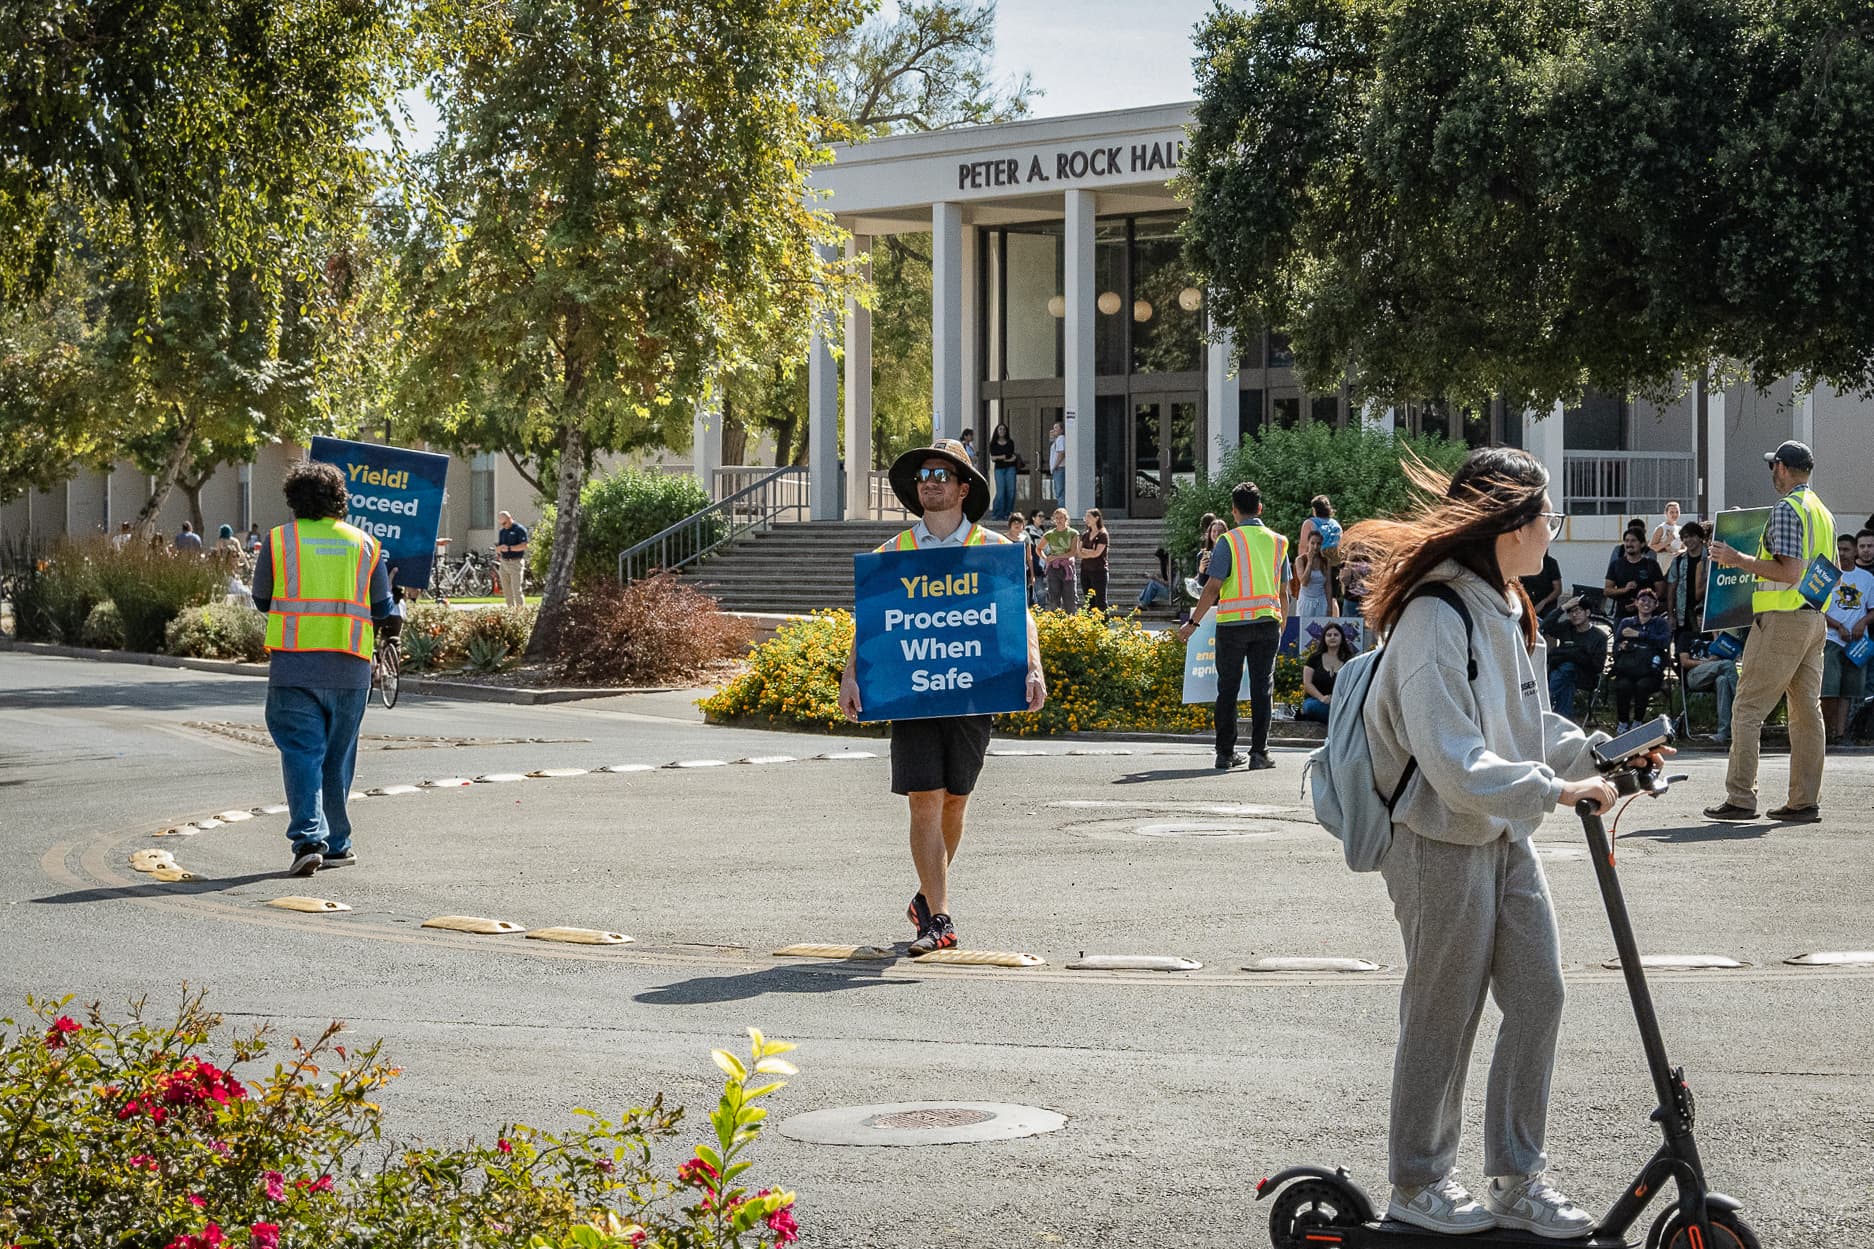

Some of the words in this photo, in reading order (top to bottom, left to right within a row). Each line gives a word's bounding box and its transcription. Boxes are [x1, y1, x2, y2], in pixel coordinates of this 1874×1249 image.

[958, 159, 1019, 190] PETER
[1027, 154, 1049, 183] A.
[1056, 146, 1122, 180] ROCK
[346, 463, 409, 490] Yield!
[900, 572, 979, 599] Yield!
[1716, 573, 1737, 587] One
[1739, 573, 1750, 584] or
[885, 603, 997, 631] Proceed
[900, 638, 982, 661] When
[911, 667, 974, 692] Safe
